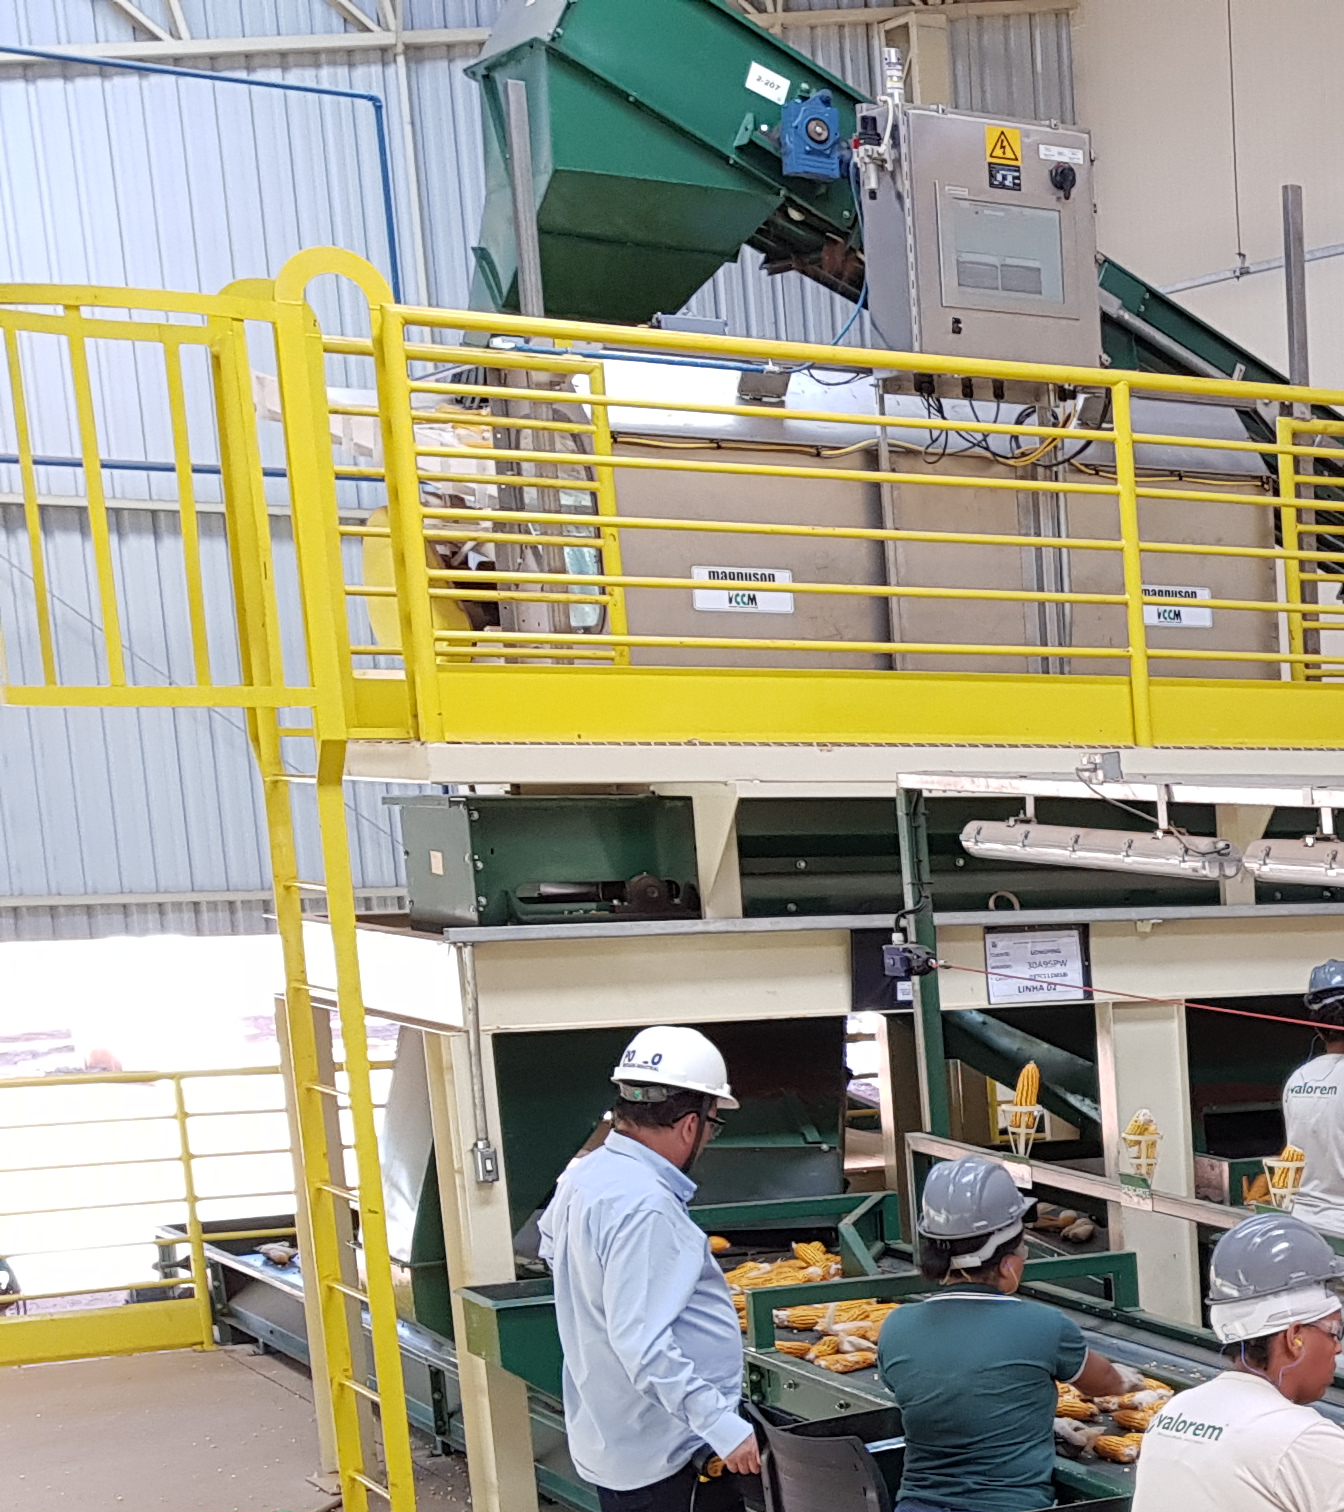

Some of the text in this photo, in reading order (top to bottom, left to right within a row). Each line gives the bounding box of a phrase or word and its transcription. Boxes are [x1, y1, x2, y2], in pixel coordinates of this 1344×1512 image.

[756, 75, 781, 91] 2-207
[1018, 984, 1045, 994] LINHA
[1290, 1081, 1338, 1096] valorem
[1156, 1412, 1223, 1441] valorem
